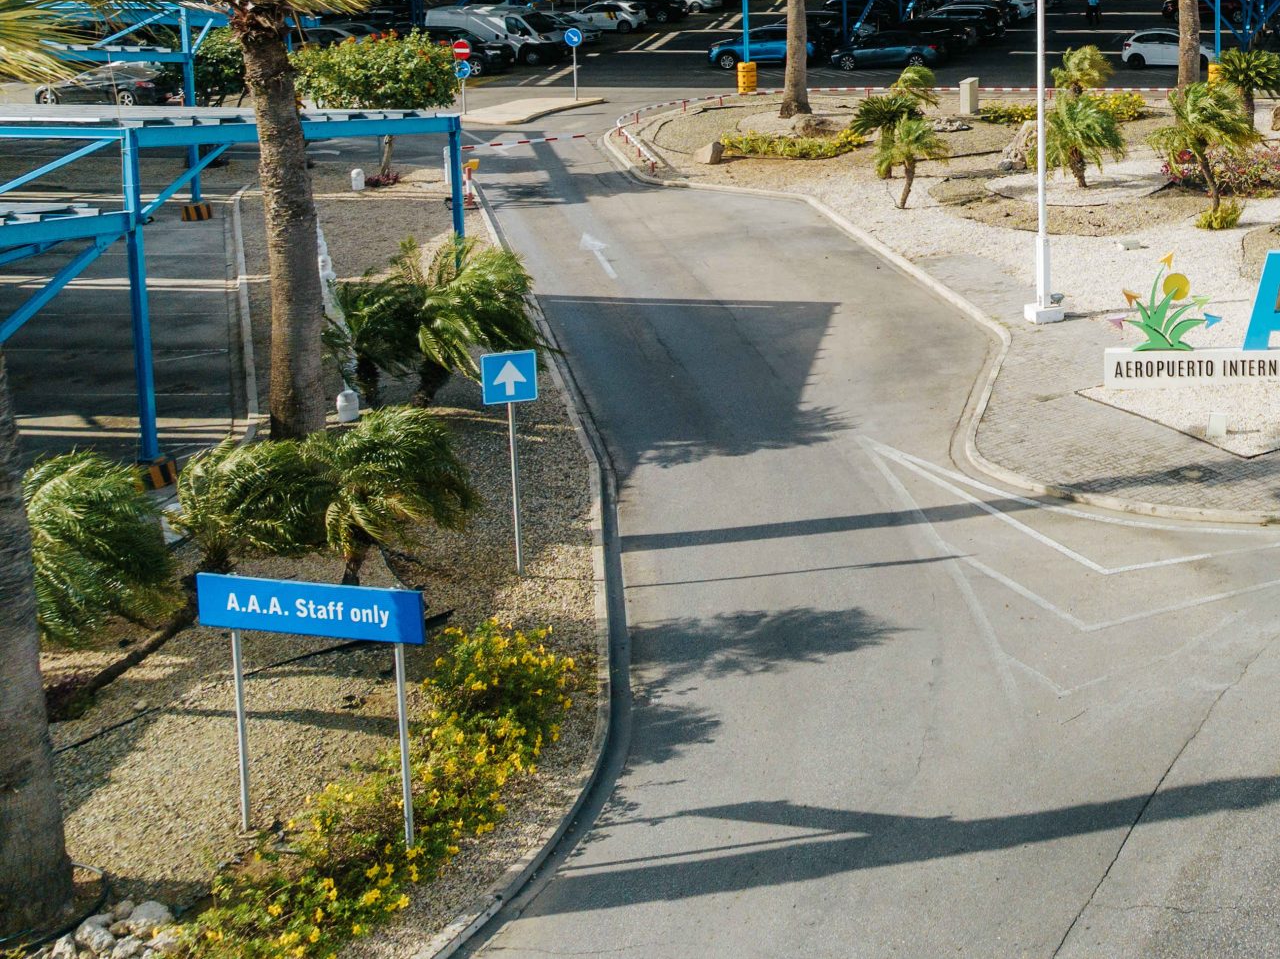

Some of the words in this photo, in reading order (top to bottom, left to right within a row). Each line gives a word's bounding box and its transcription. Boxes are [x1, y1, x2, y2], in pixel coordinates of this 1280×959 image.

[1114, 359, 1215, 378] AEROPUERTO
[227, 592, 289, 616] A.A.A.
[295, 598, 344, 621] Staff
[350, 605, 390, 628] only
